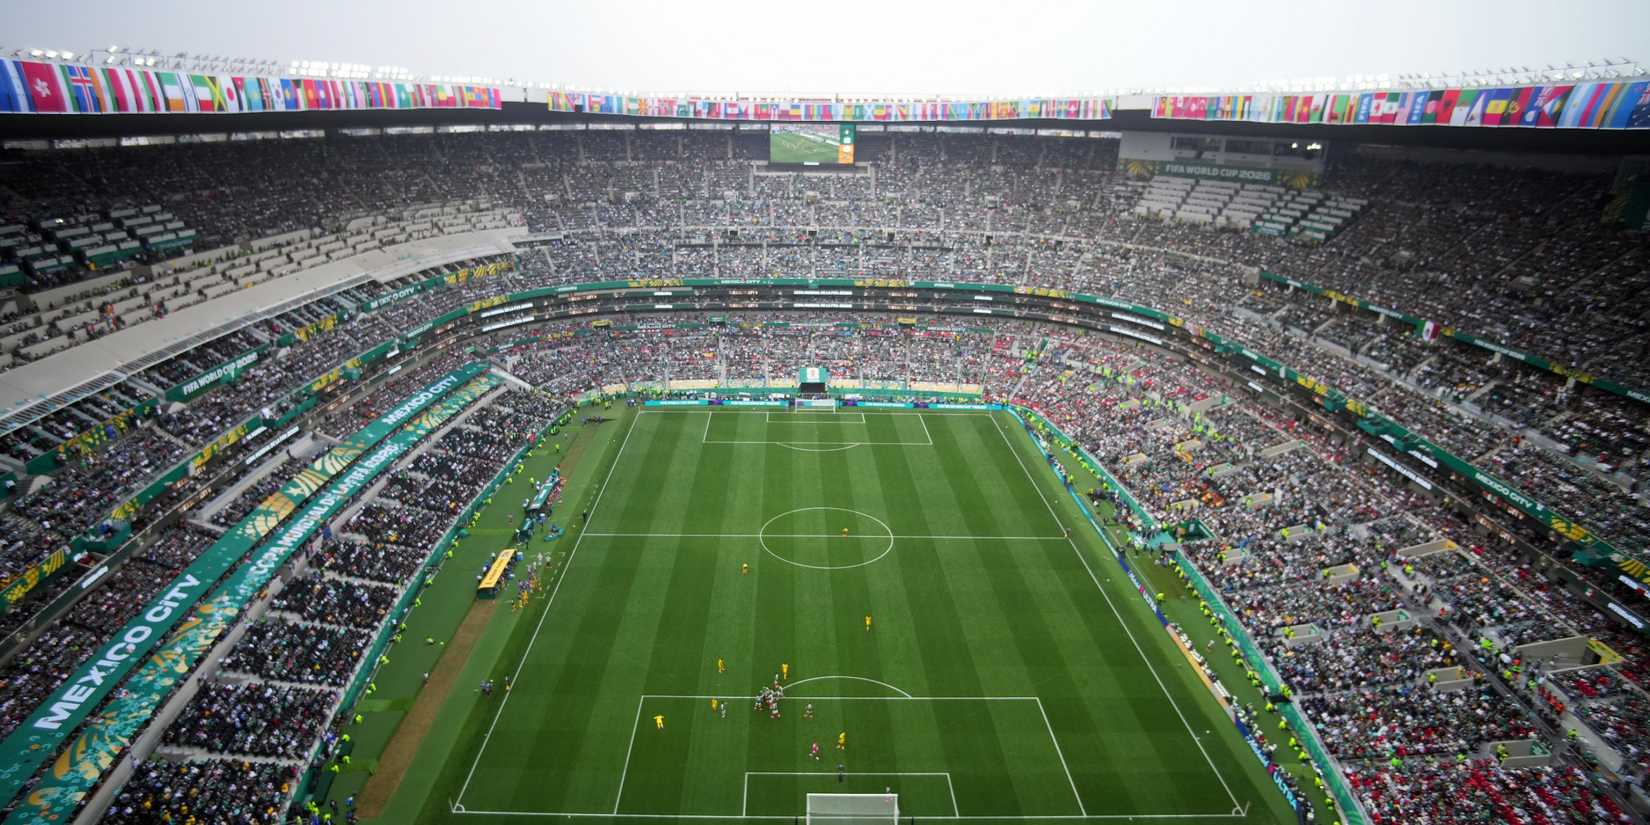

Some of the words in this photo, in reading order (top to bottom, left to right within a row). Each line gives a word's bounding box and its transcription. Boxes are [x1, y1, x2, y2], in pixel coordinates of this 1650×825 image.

[1166, 164, 1185, 174] FIFA
[1186, 166, 1219, 177] WORLD
[1220, 168, 1238, 177] CUP
[183, 381, 200, 395] FIFA
[198, 368, 223, 388] WORLD
[382, 392, 433, 424] MEXICO
[429, 375, 458, 393] CITY
[1475, 472, 1510, 495] MEXICO
[1509, 492, 1533, 508] CITY
[249, 547, 289, 576] COPA
[277, 506, 330, 547] MUNDIAL
[34, 625, 152, 729] MEXICO
[145, 574, 200, 622] CITY
[1273, 771, 1297, 811] ULTRA
